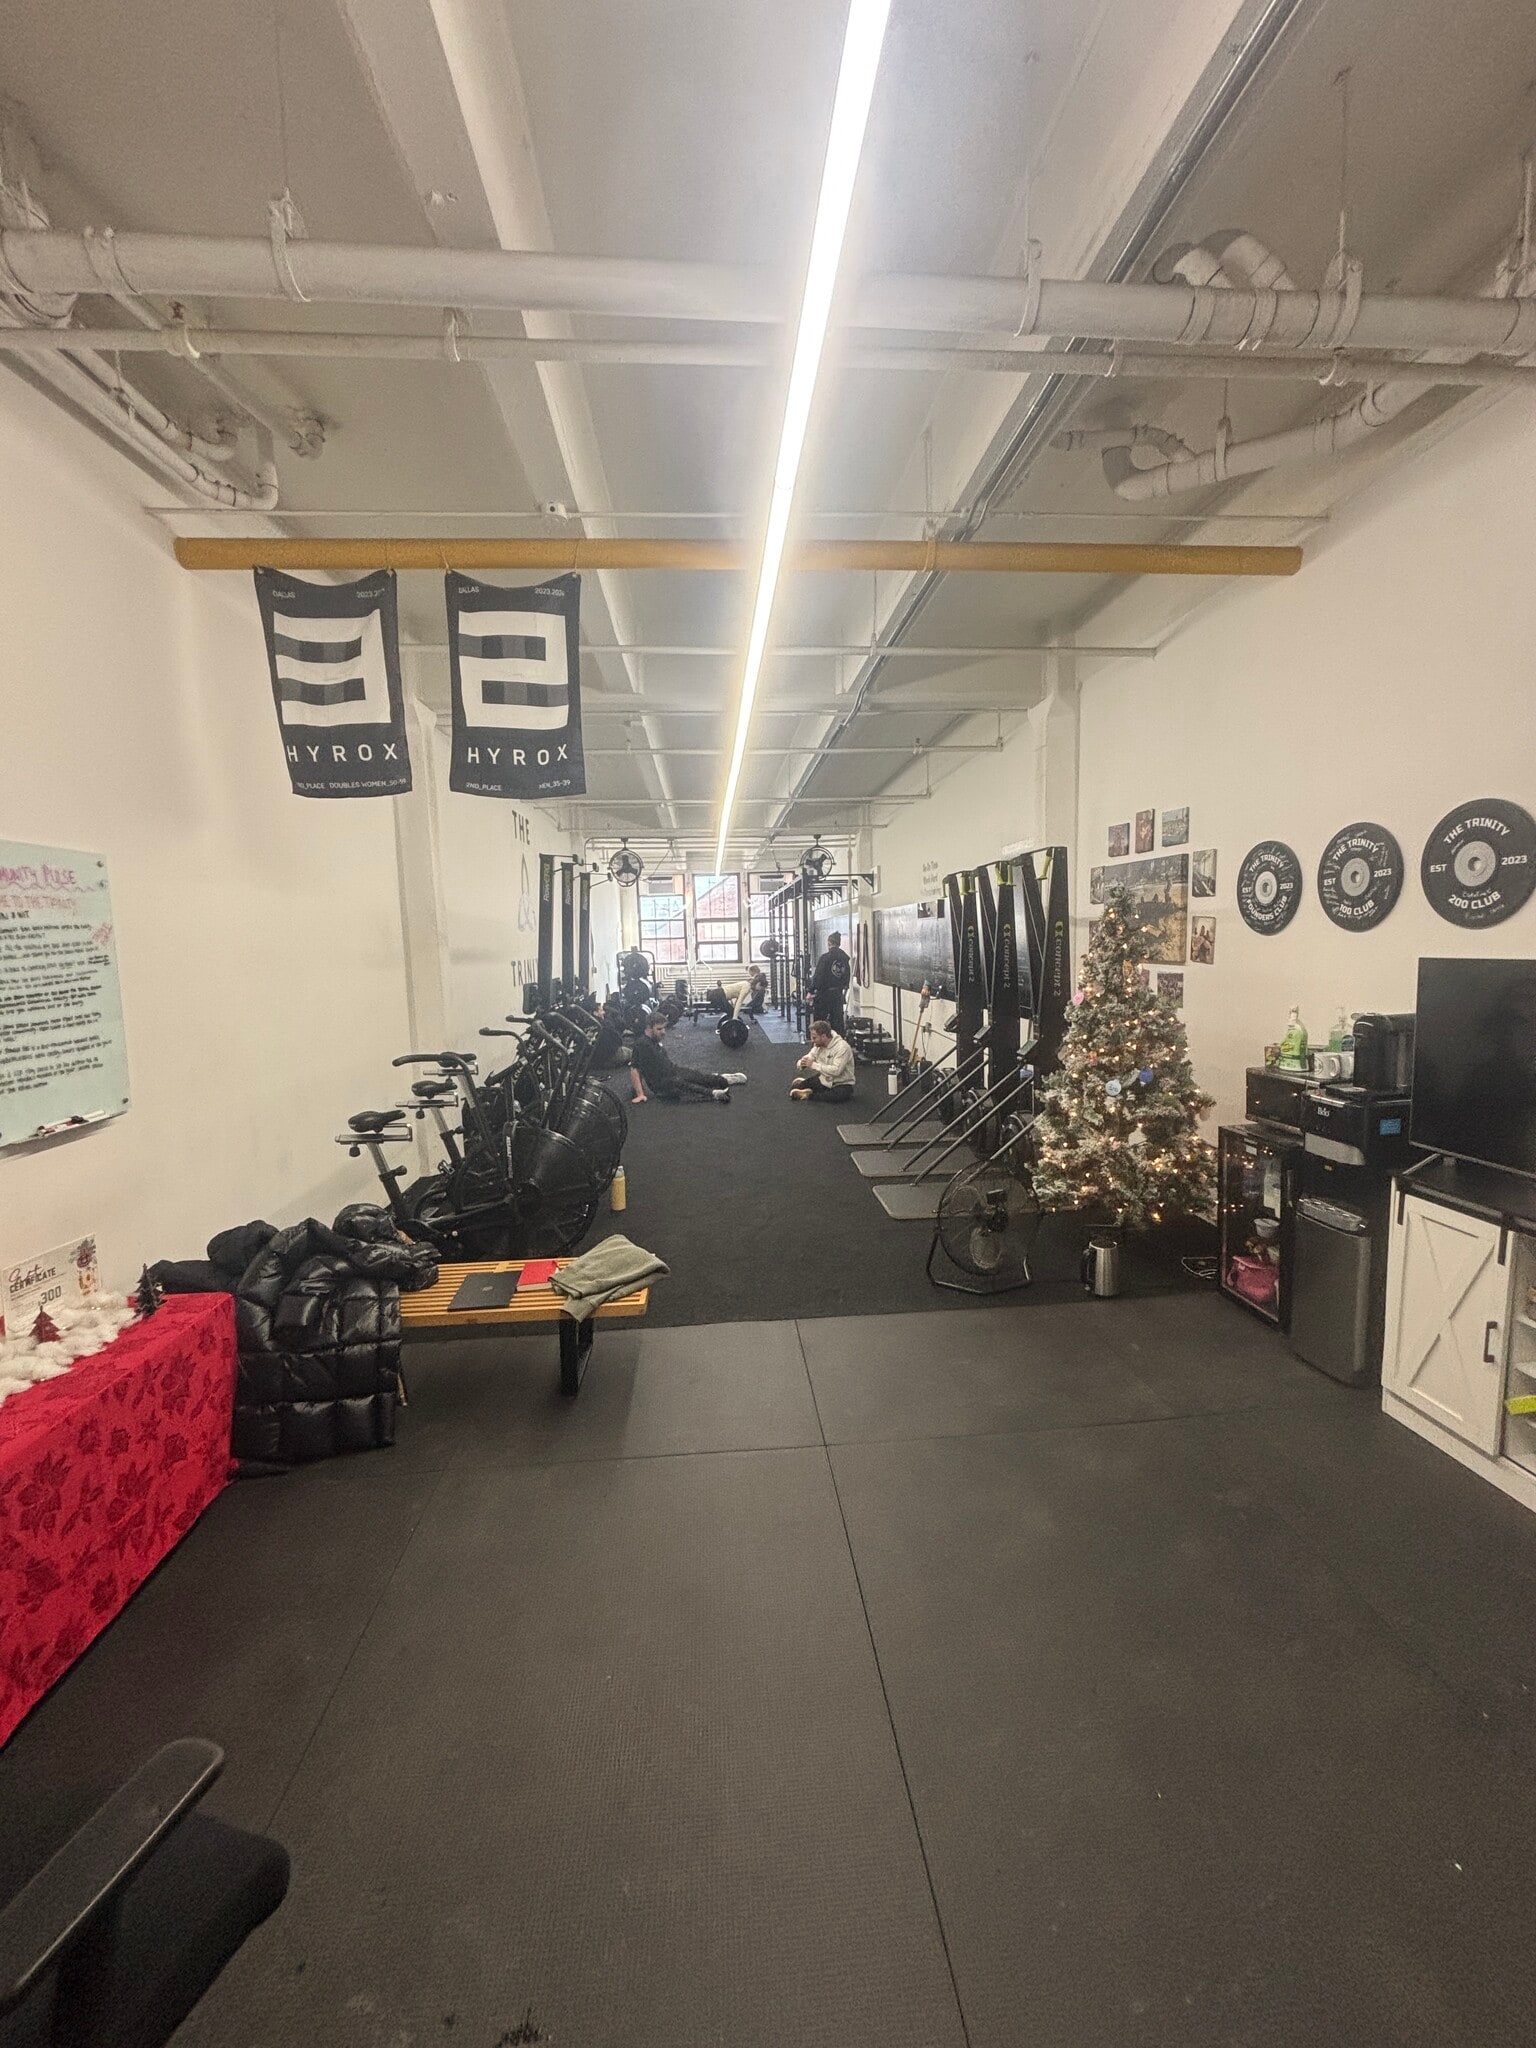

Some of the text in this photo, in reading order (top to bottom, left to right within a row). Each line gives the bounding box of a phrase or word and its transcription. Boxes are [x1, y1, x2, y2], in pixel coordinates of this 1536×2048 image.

[286, 743, 398, 762] HYROX
[467, 743, 568, 766] HYROX
[329, 781, 361, 790] DOUBLES
[512, 810, 530, 845] THE
[1443, 817, 1510, 844] THE TRINITY
[1332, 844, 1347, 861] THE
[1347, 838, 1379, 853] TRINITY
[1249, 854, 1285, 872] THE TRINITY
[1430, 854, 1528, 873] EST 2023
[1323, 867, 1392, 886] EST 2023
[1242, 882, 1293, 894] EST 2023
[1246, 895, 1288, 920] FOUNDERS CLUB
[1339, 903, 1352, 915] 100
[1353, 899, 1375, 916] CLUB
[1448, 894, 1469, 909] 200
[1470, 891, 1501, 910] CLUB
[1053, 938, 1062, 987] concept
[40, 1285, 61, 1305] 300
